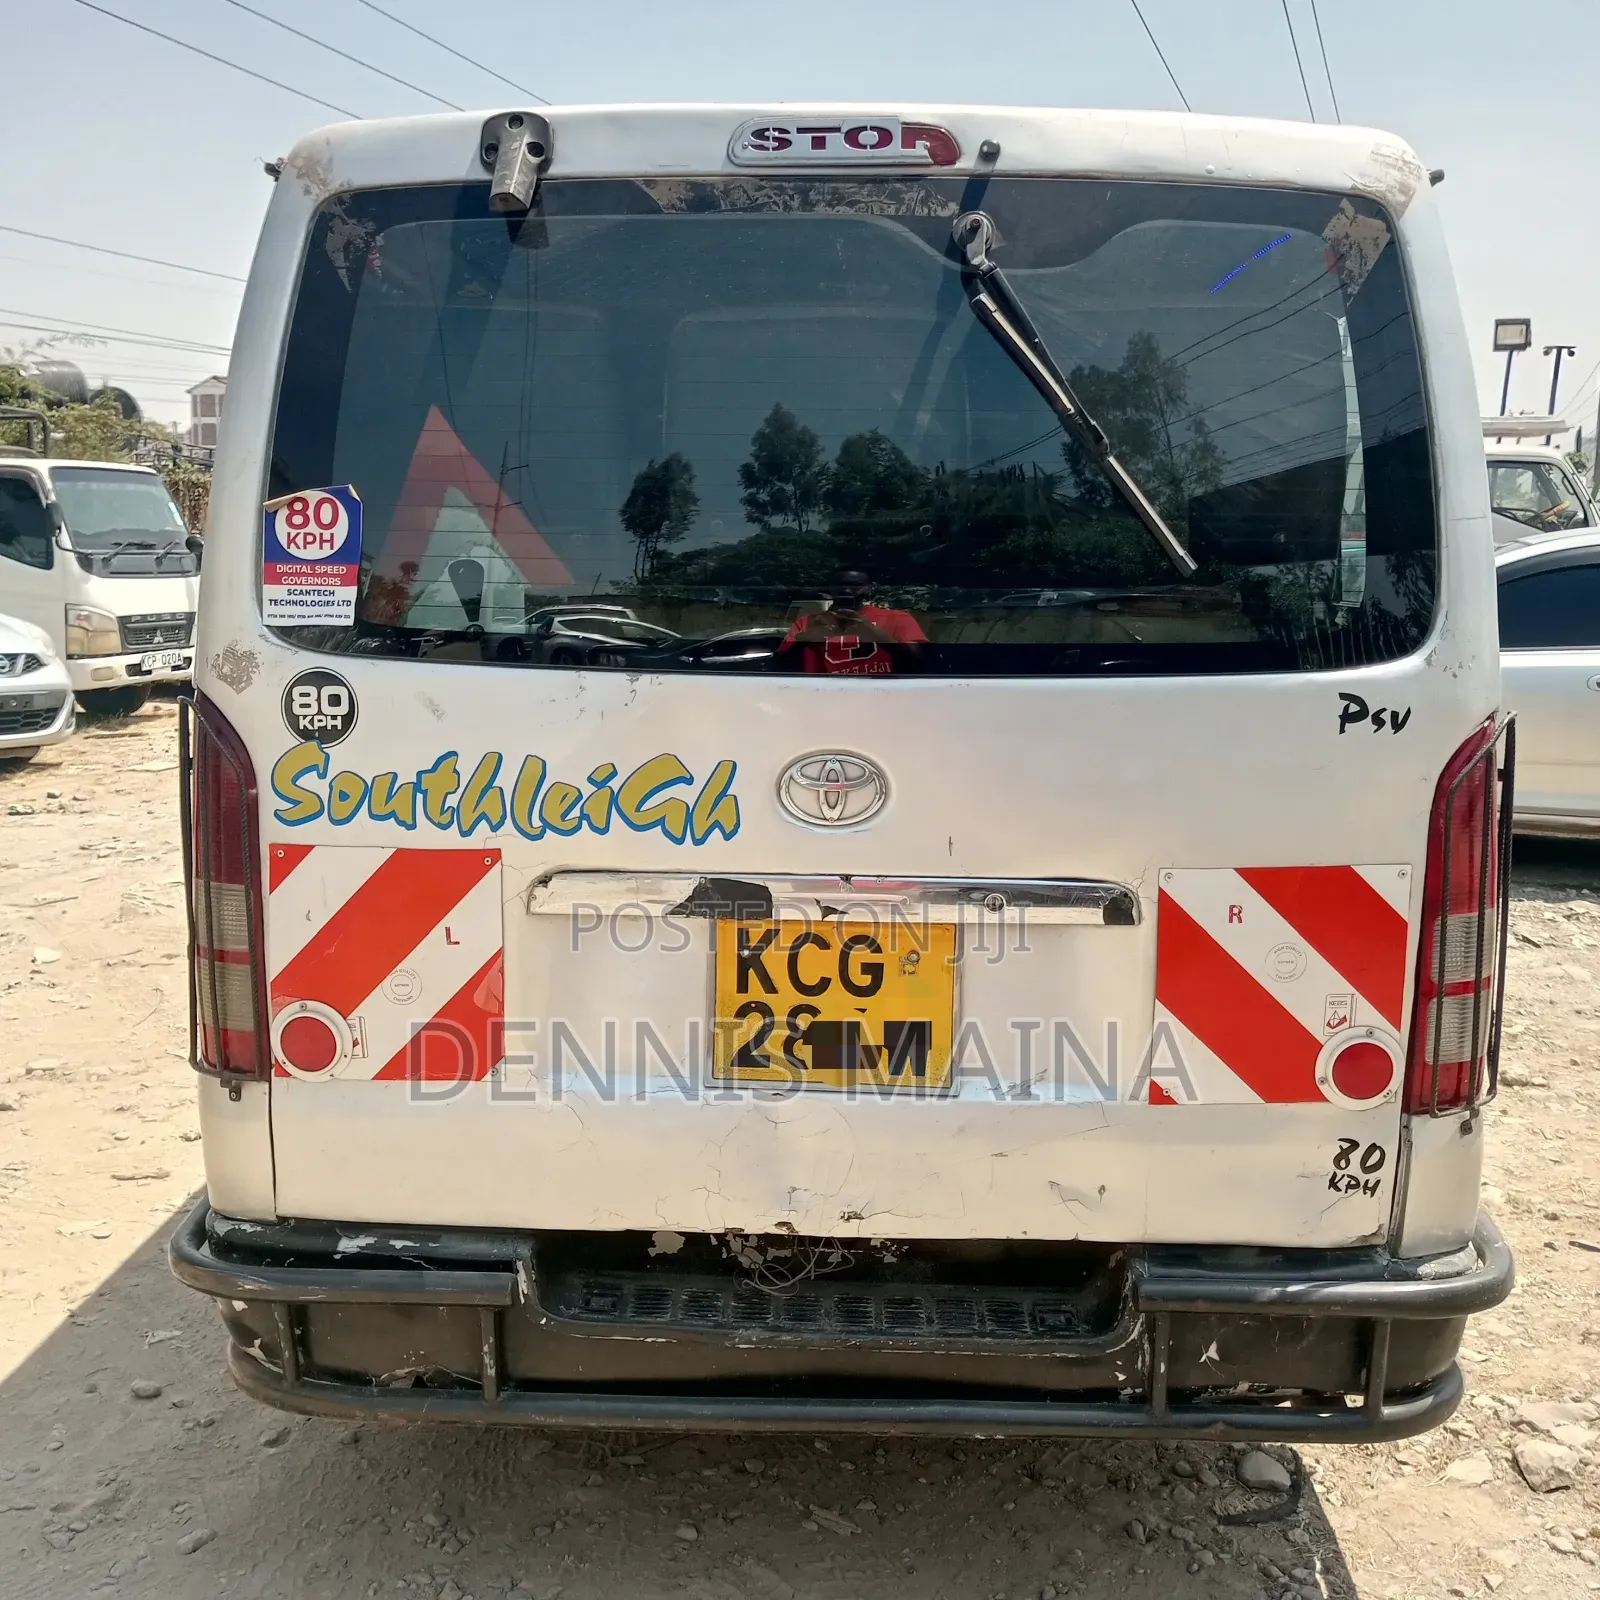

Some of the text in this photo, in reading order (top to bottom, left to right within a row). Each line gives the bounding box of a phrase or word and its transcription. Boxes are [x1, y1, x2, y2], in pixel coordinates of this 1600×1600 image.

[285, 496, 340, 531] 80
[286, 532, 335, 551] KPH
[276, 564, 347, 575] DIGITAL SPEED
[281, 576, 342, 586] GOVERNORS
[286, 588, 336, 597] SCANTECH
[268, 599, 352, 607] TECHNOLOGIES LTD
[161, 652, 183, 666] 020A
[292, 686, 349, 715] 80
[299, 715, 342, 730] KPH
[1228, 904, 1243, 923] R
[445, 926, 460, 945] L
[736, 928, 885, 998] KCG
[1333, 1138, 1386, 1174] 80
[1328, 1171, 1381, 1198] KPH
